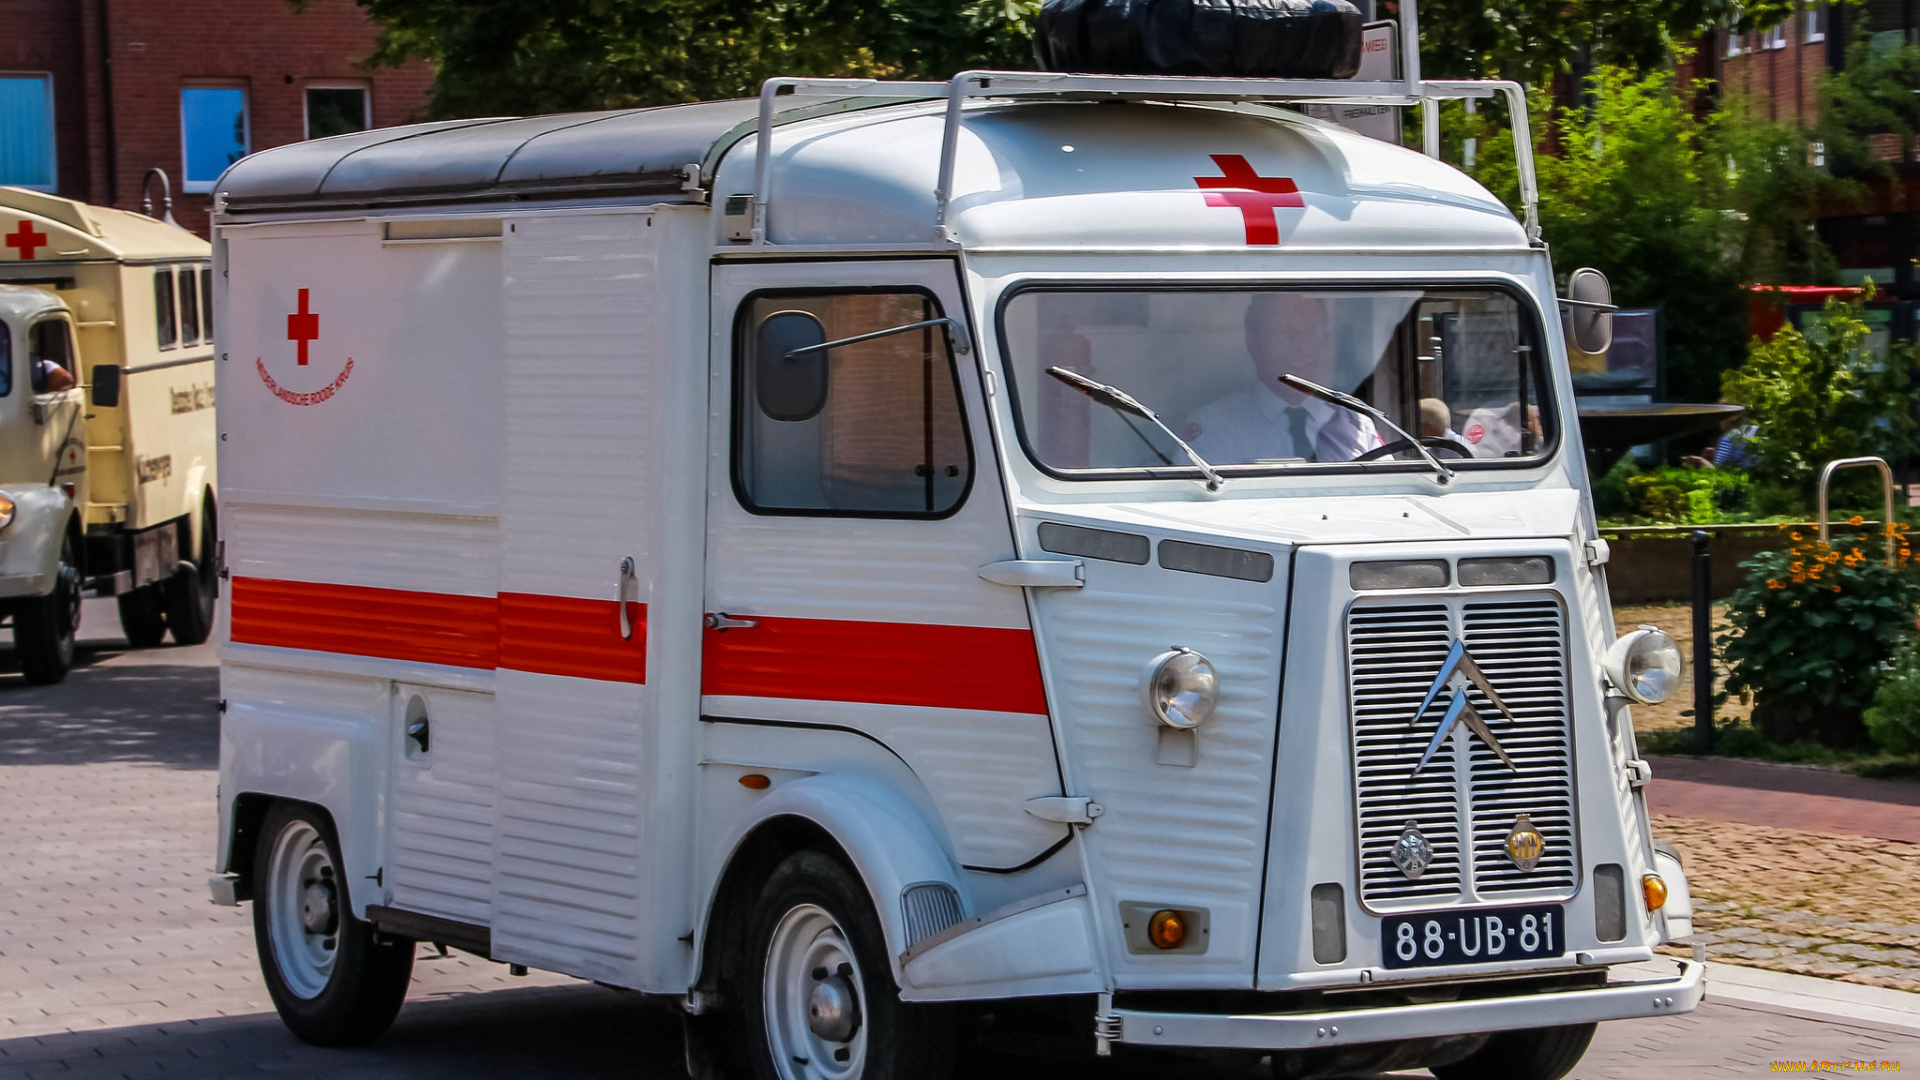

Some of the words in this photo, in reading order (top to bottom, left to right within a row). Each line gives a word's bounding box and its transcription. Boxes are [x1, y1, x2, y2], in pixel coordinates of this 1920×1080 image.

[310, 382, 335, 405] ROODE
[335, 357, 354, 391] KRUIS
[1396, 912, 1553, 961] 88-UB-81
